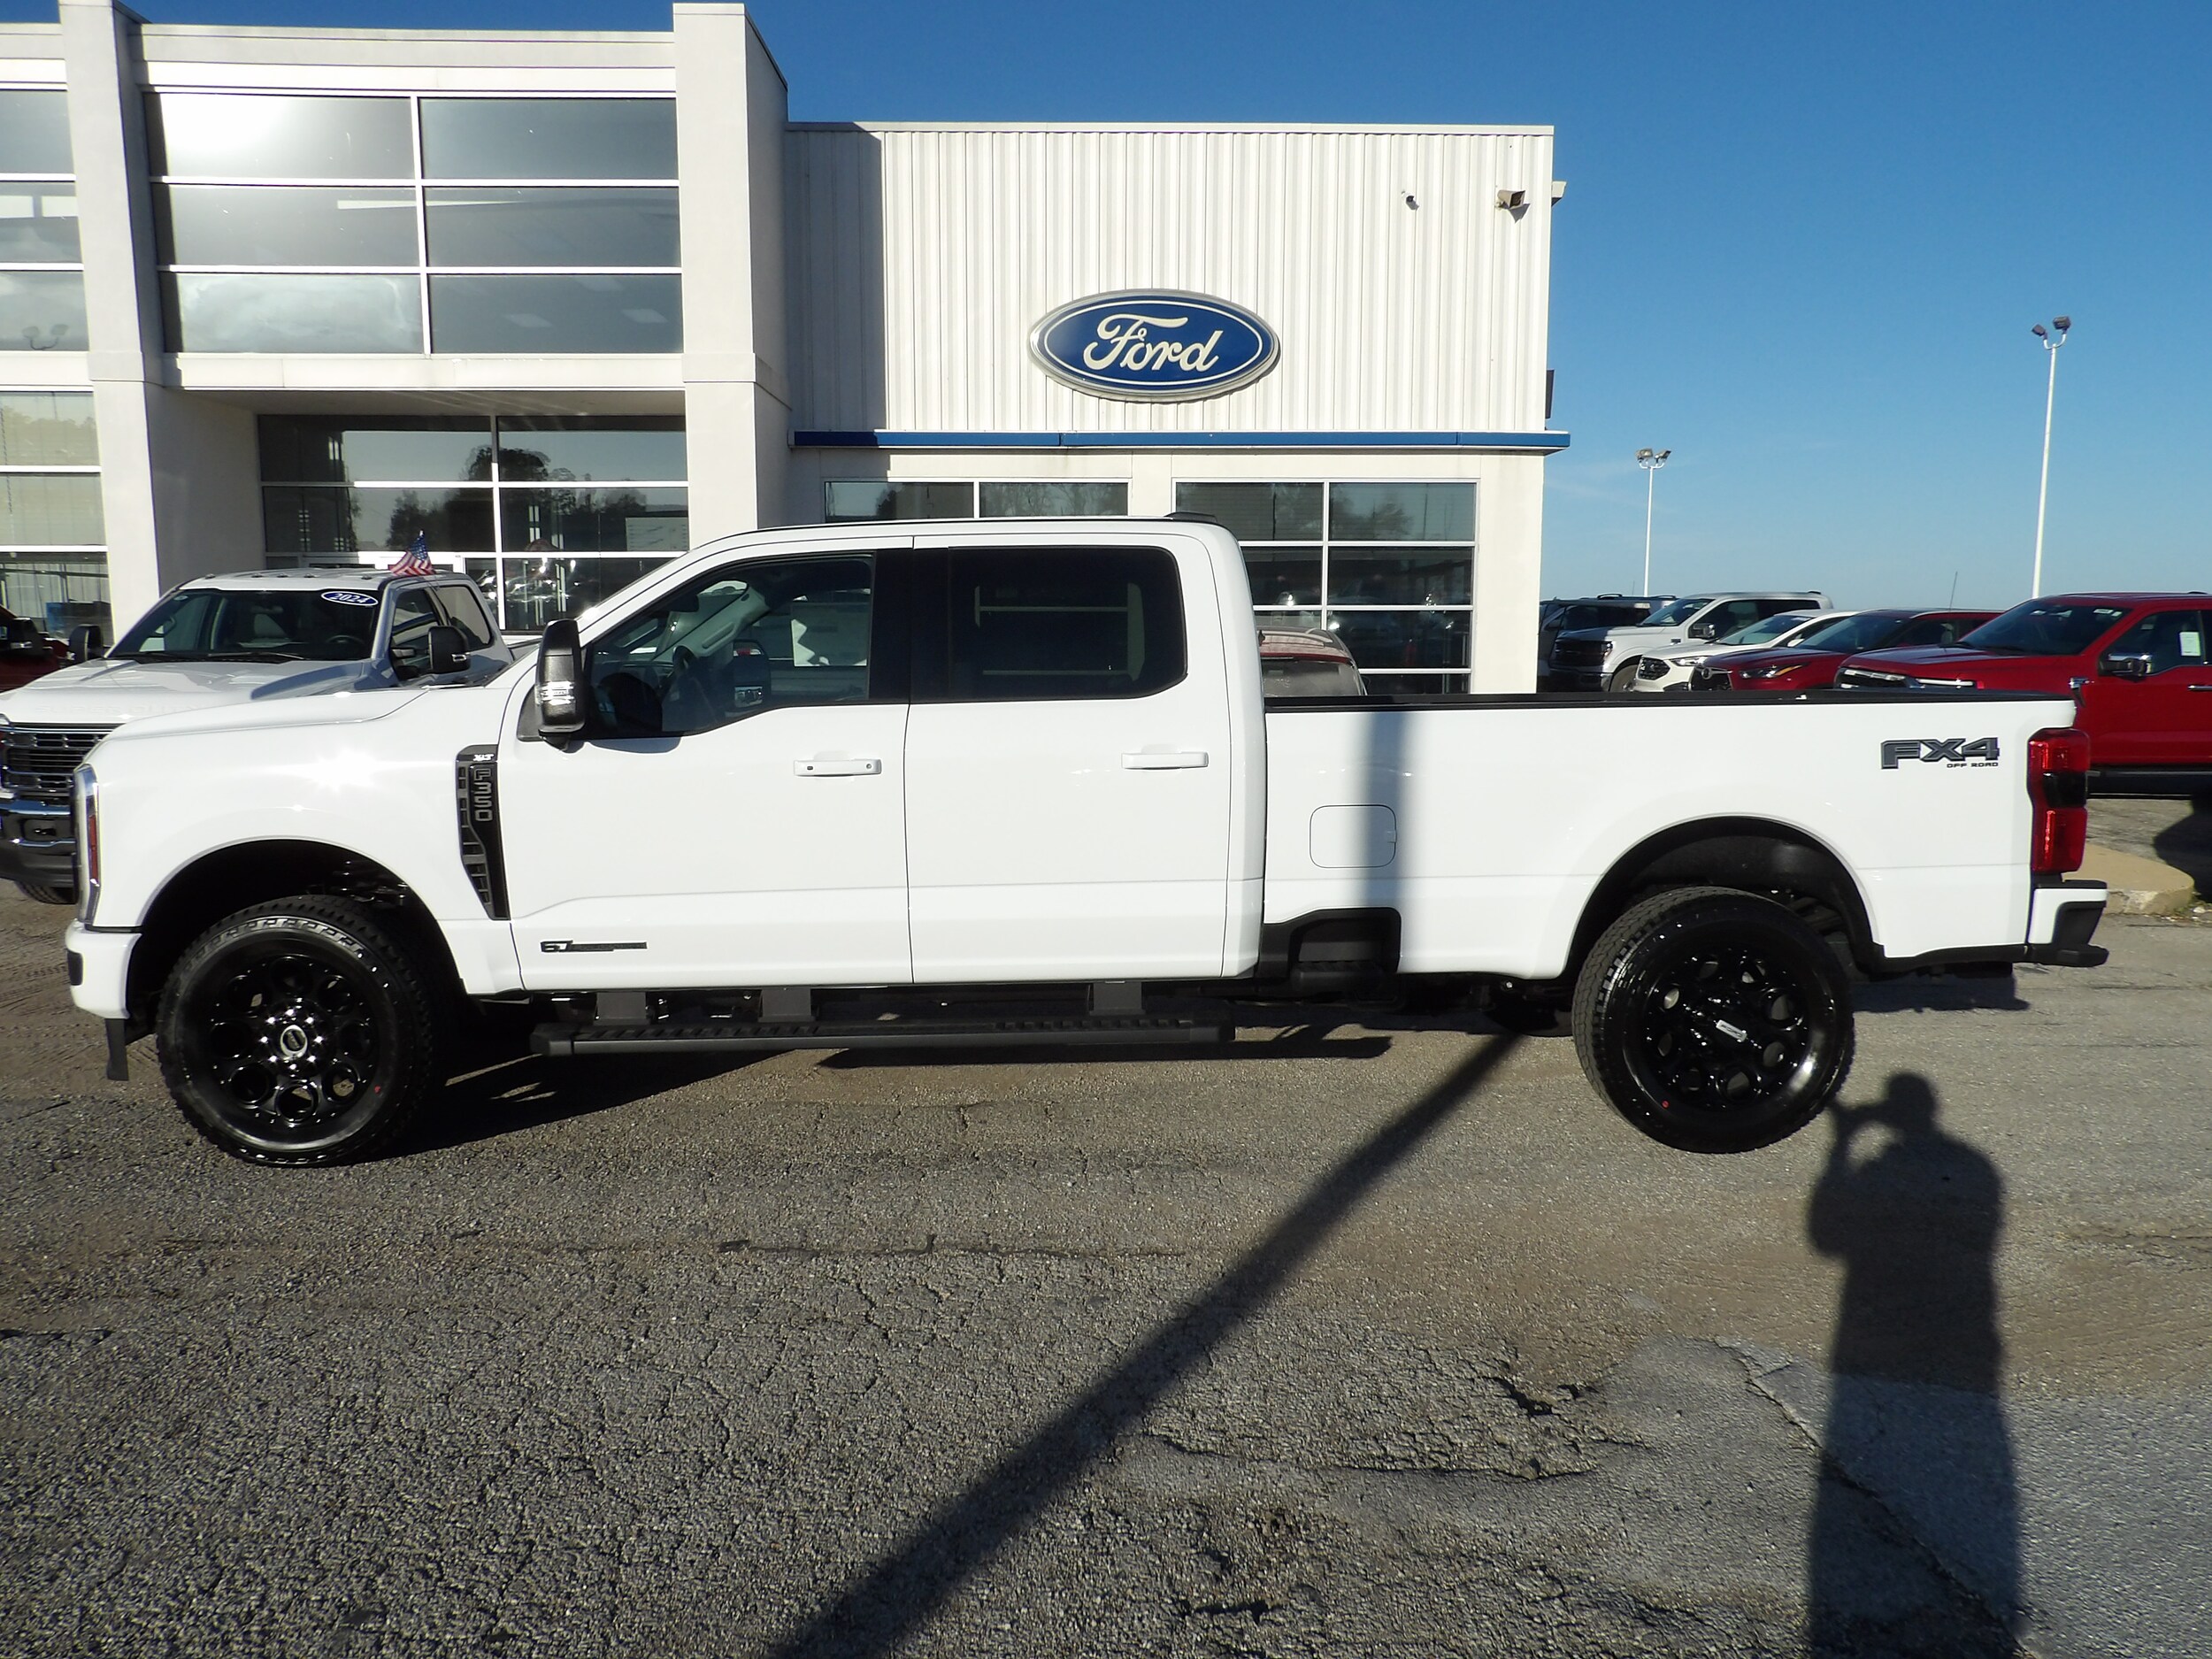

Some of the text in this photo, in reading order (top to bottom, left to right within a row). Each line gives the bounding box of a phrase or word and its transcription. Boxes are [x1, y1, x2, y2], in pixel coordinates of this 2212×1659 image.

[1083, 313, 1224, 372] Ford
[328, 593, 371, 603] 2024
[1880, 737, 2000, 770] FX4
[473, 768, 493, 821] F350
